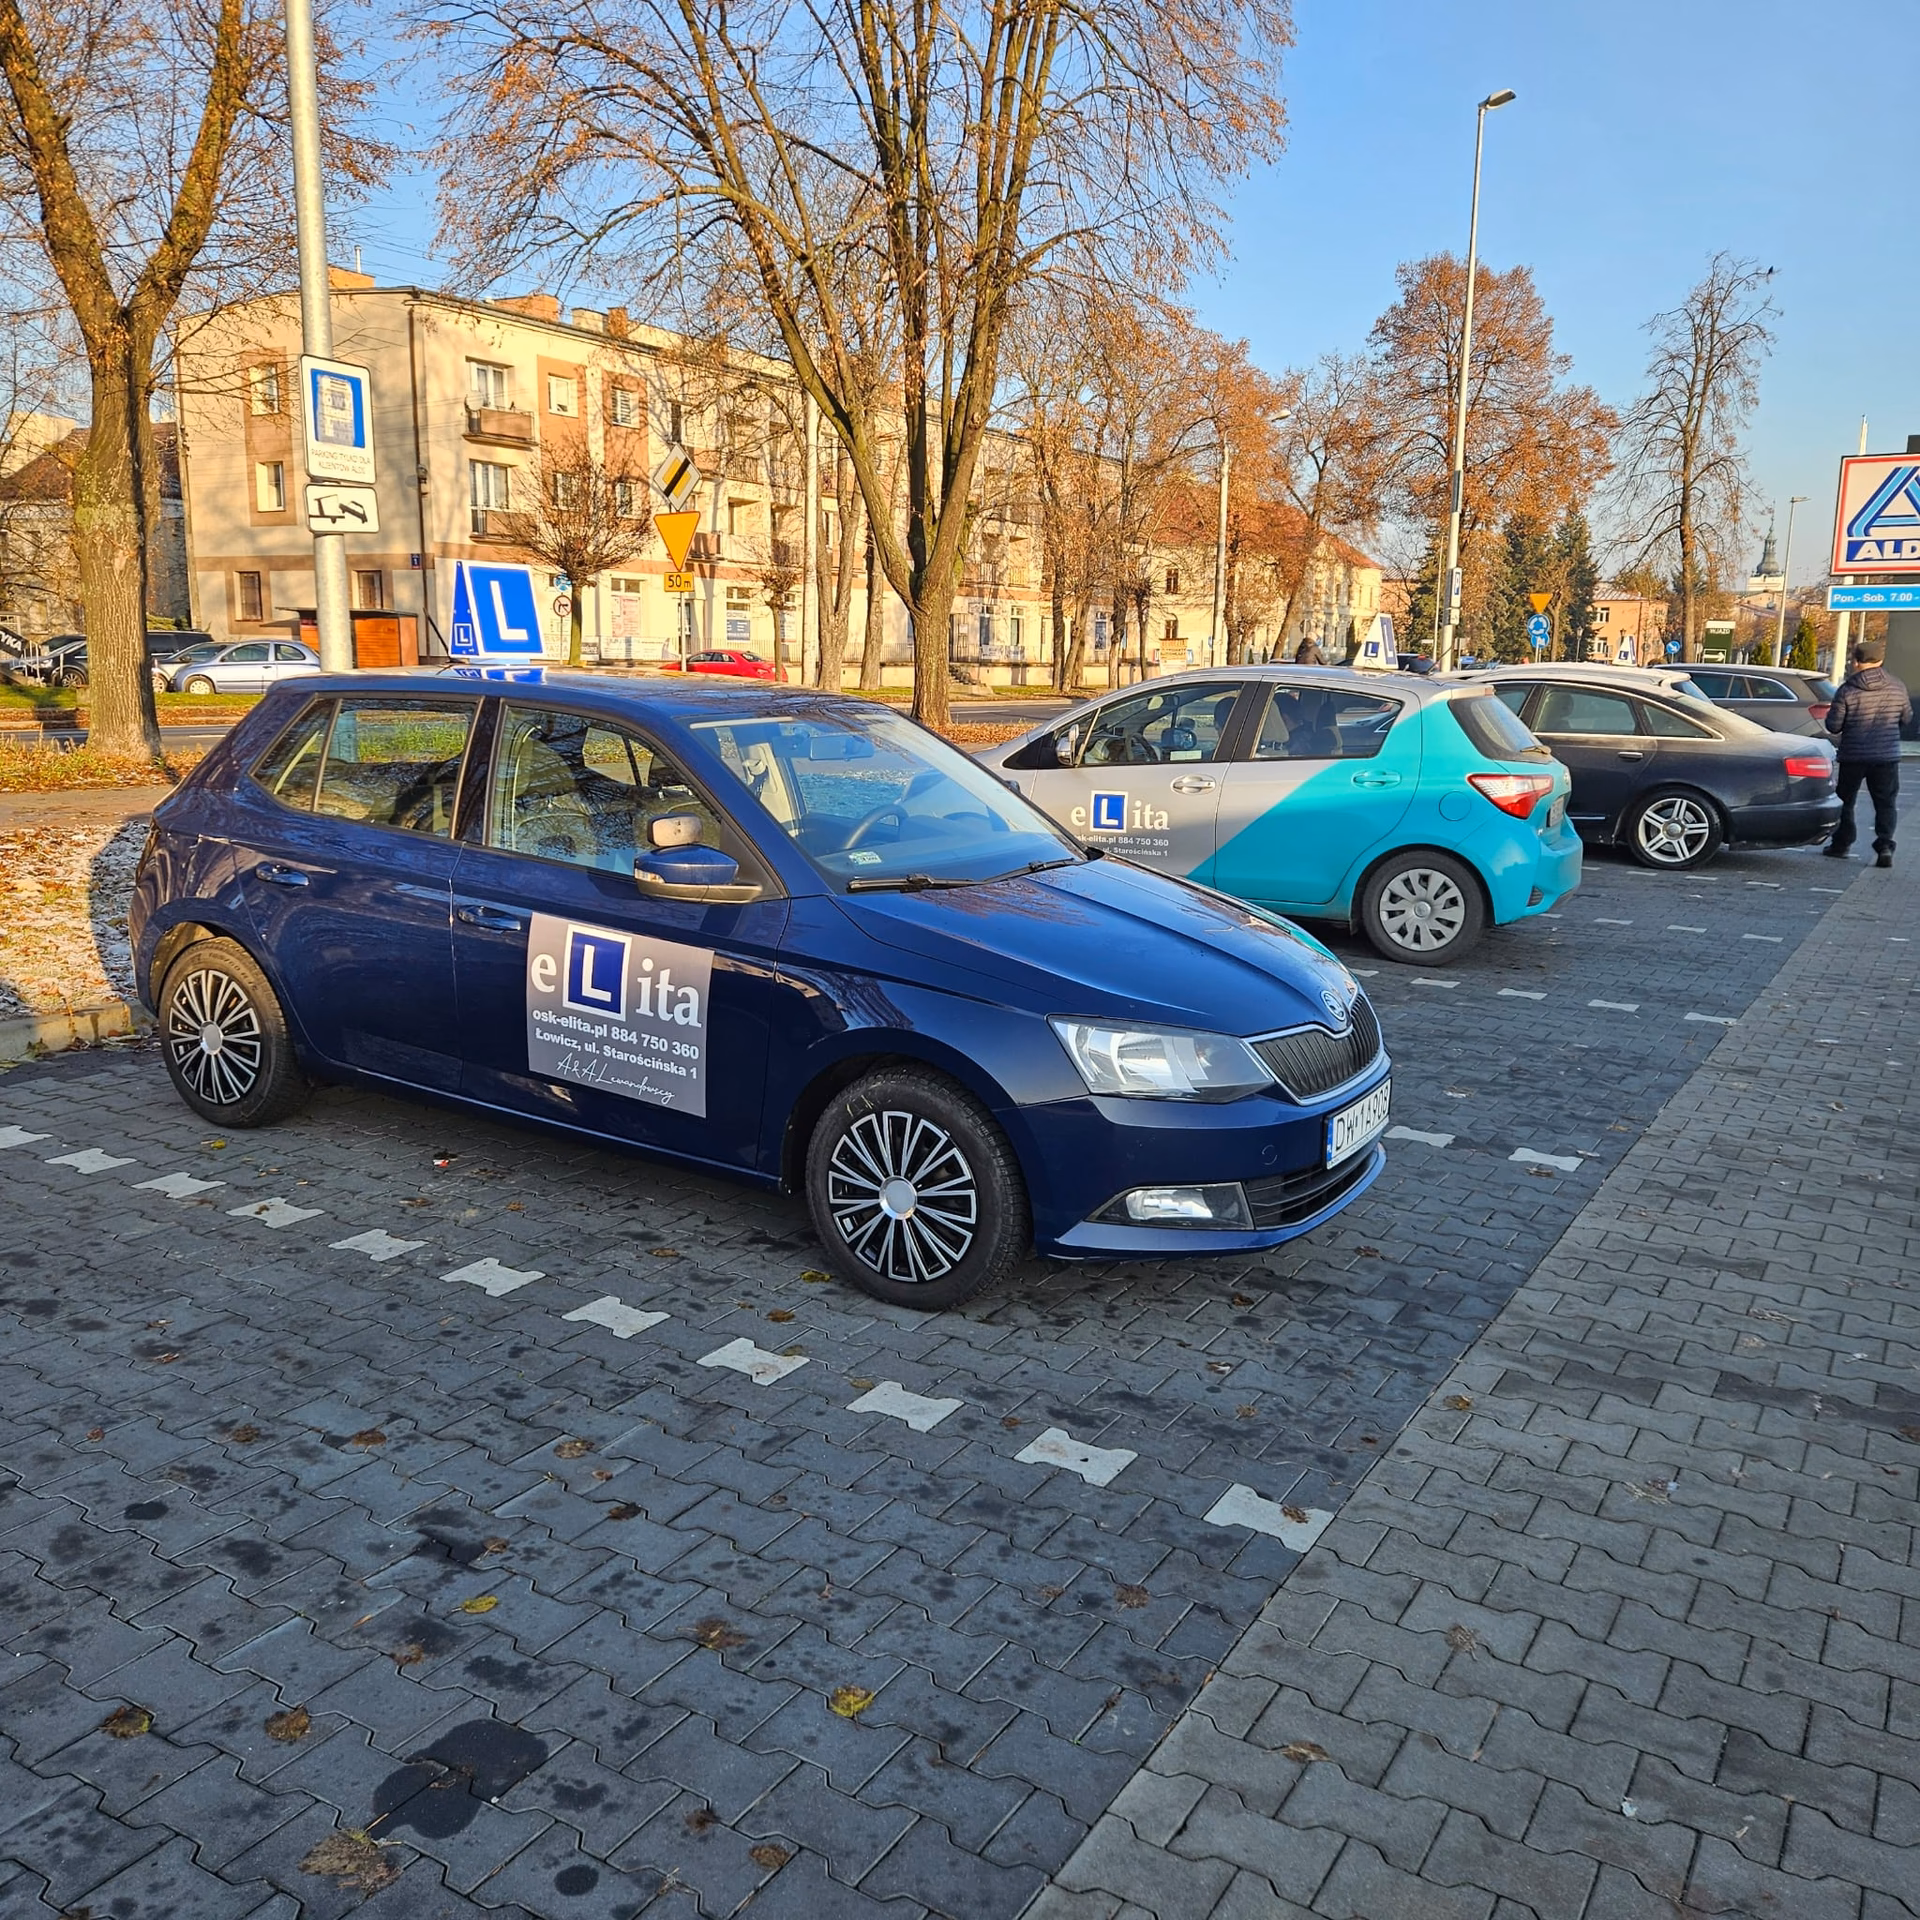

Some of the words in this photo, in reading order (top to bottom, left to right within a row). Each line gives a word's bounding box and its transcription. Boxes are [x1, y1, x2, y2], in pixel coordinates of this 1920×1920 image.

[668, 574, 682, 588] 50
[684, 580, 692, 588] m
[1863, 592, 1887, 603] Sob.
[489, 580, 529, 641] L
[1383, 624, 1394, 658] L
[1071, 796, 1170, 831] eLita
[1077, 834, 1117, 845] sk-elita.pl
[1118, 836, 1134, 845] 884
[1136, 837, 1151, 846] 750
[1153, 838, 1169, 847] 360
[1163, 849, 1169, 857] 1
[530, 936, 702, 1028] eLita
[532, 1008, 608, 1038] osk-elita.pl
[611, 1026, 638, 1045] 884
[641, 1034, 668, 1052] 750
[671, 1041, 700, 1060] 360
[535, 1027, 582, 1052] Łowicz,
[584, 1041, 600, 1055] ul.
[603, 1045, 687, 1077] Starościńska
[690, 1067, 698, 1079] 1
